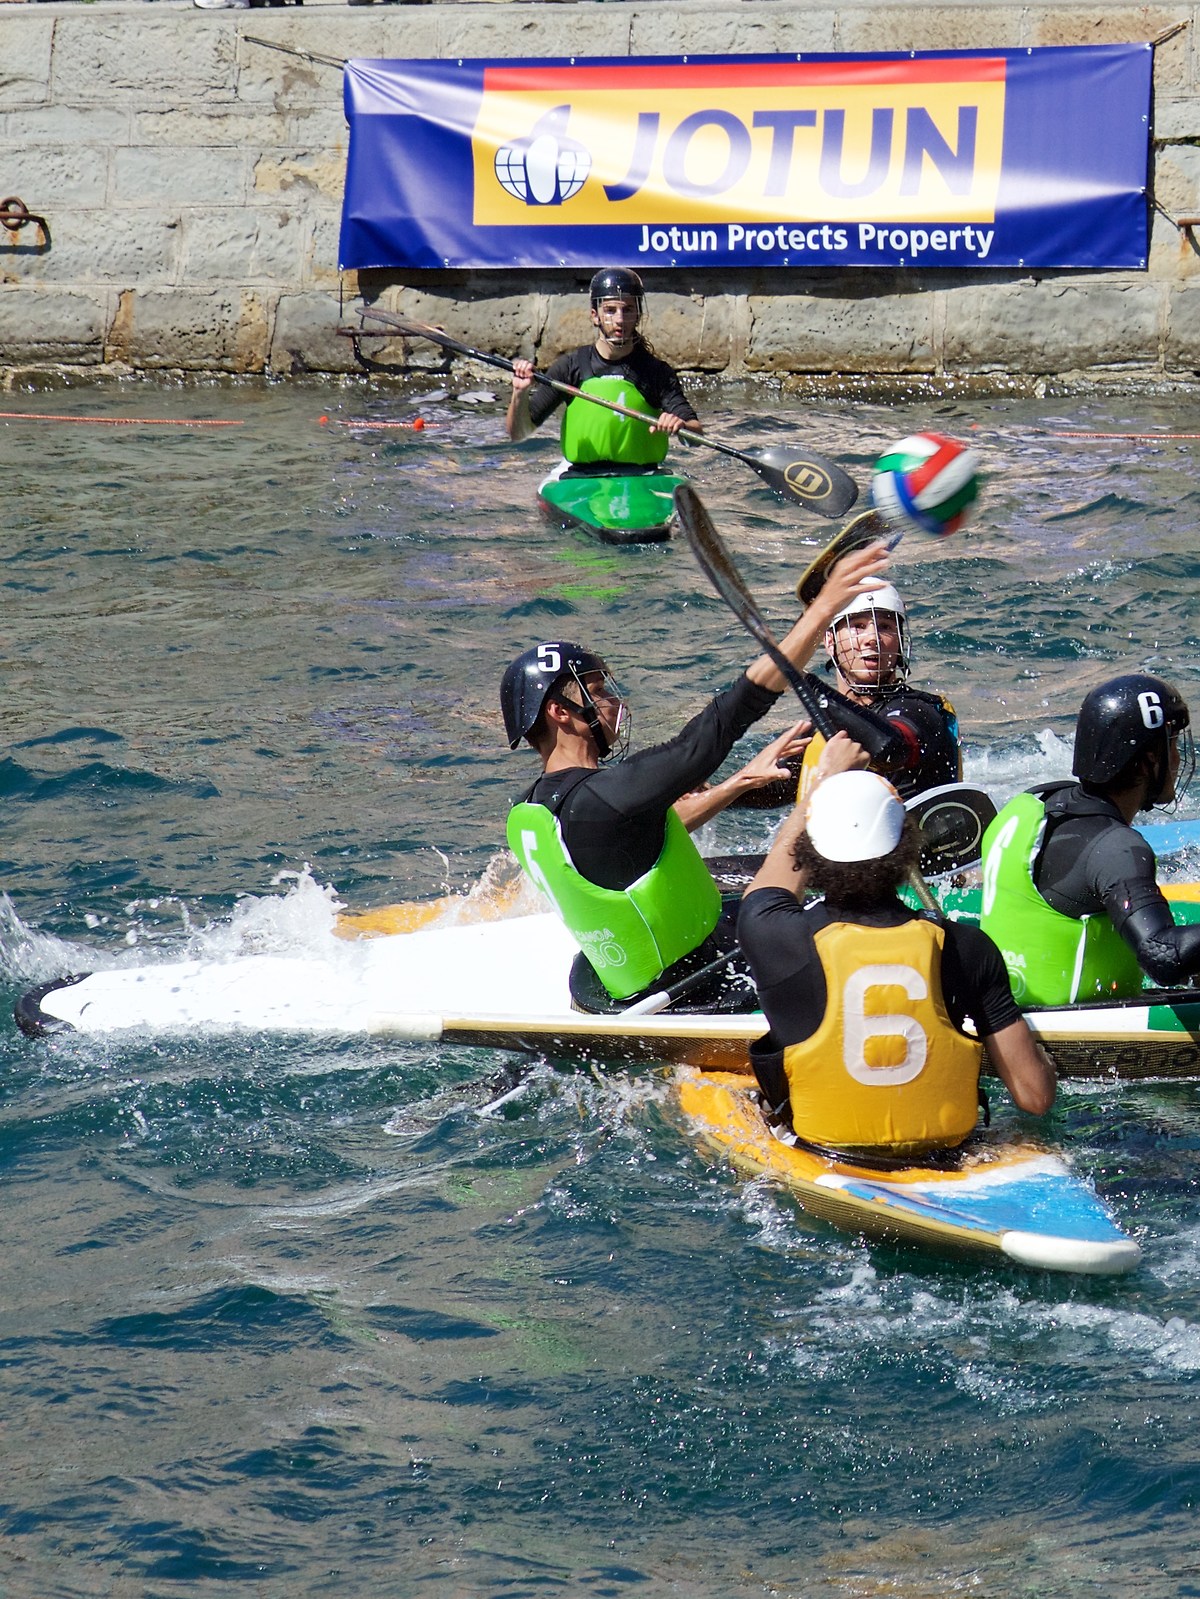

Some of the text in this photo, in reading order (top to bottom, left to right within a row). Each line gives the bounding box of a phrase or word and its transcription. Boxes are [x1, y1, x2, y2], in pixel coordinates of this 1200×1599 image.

[602, 106, 979, 202] JOTUN
[638, 223, 995, 258] Jotun Protects Property
[537, 643, 561, 672] 5
[1137, 691, 1164, 729] 6
[843, 964, 928, 1086] 6
